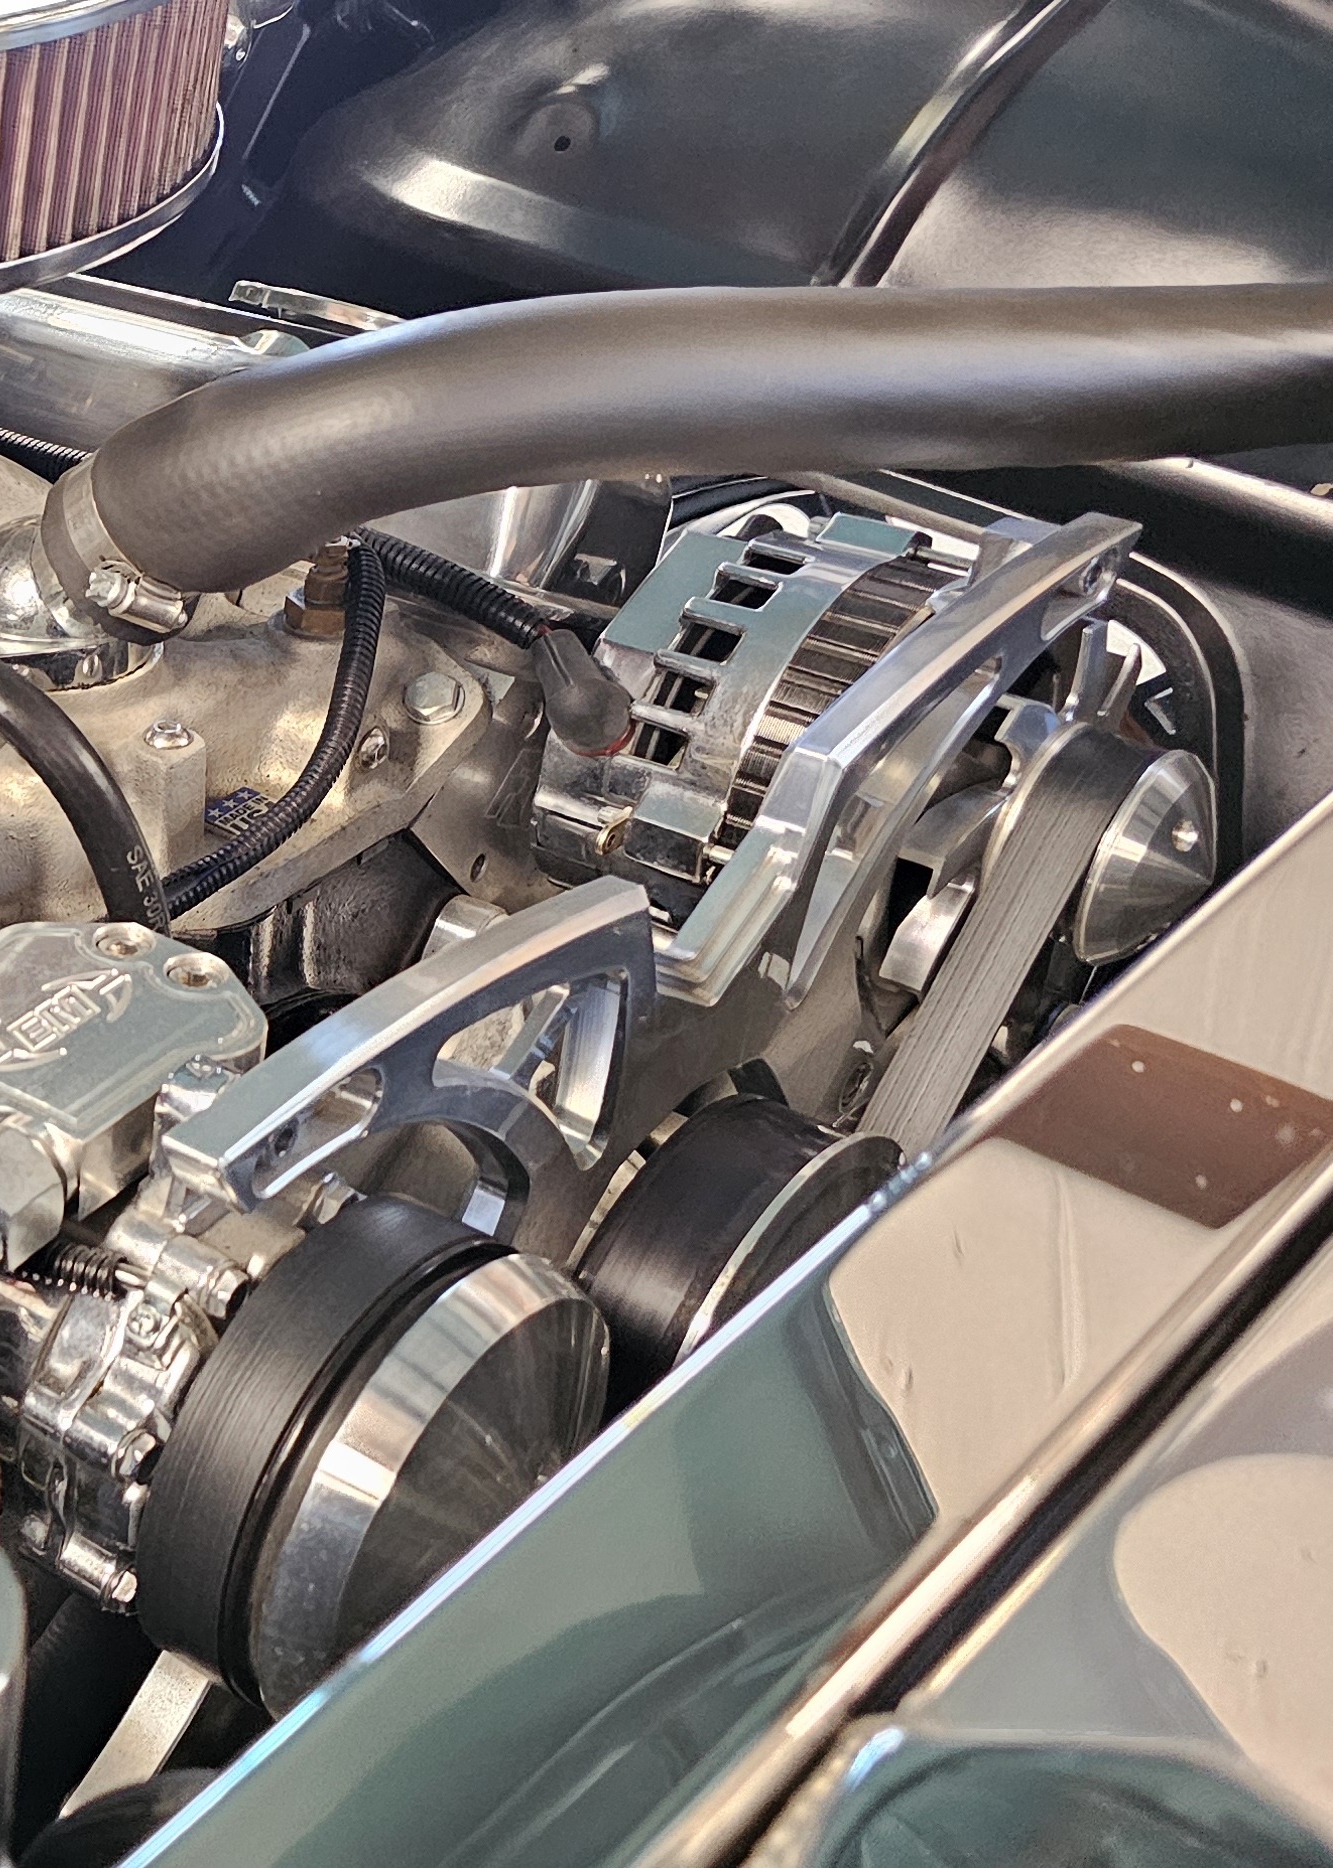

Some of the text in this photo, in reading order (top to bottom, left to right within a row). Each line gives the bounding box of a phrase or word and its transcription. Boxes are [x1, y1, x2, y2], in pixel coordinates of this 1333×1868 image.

[217, 795, 269, 825] MADE IN
[126, 845, 155, 893] SAE
